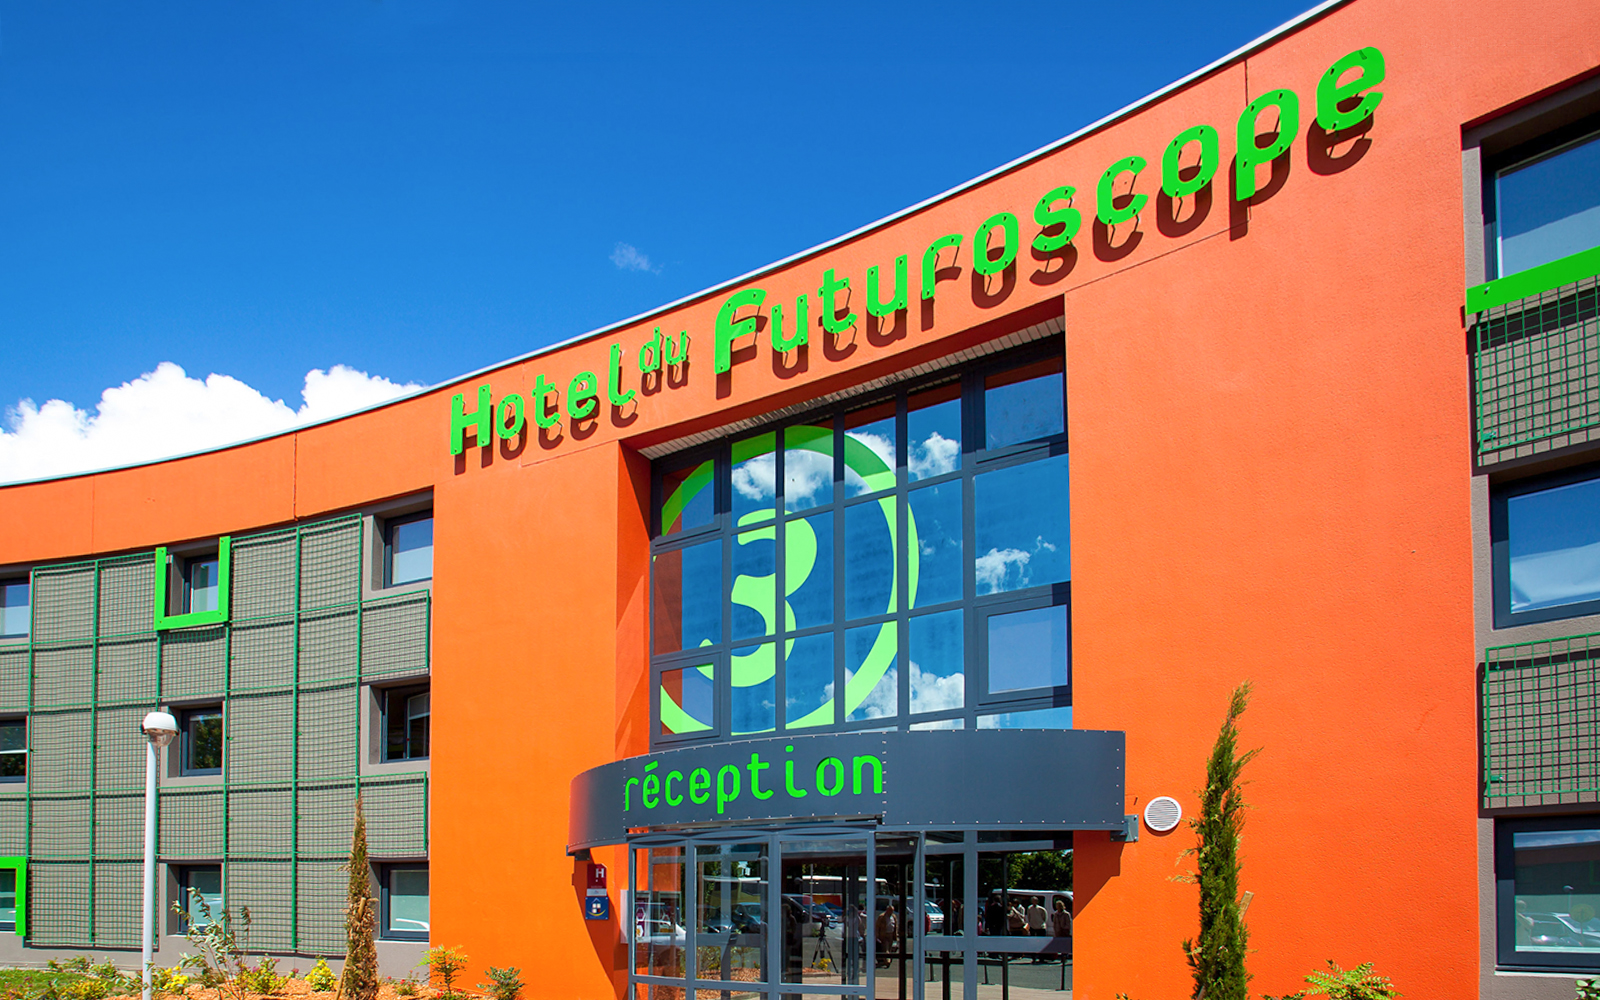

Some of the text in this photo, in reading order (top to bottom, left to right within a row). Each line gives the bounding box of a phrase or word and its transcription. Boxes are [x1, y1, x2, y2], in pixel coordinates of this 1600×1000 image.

[450, 46, 1386, 456] Hotel du Futuroscope
[696, 508, 818, 688] 3
[623, 746, 883, 815] réception
[596, 868, 604, 878] H
